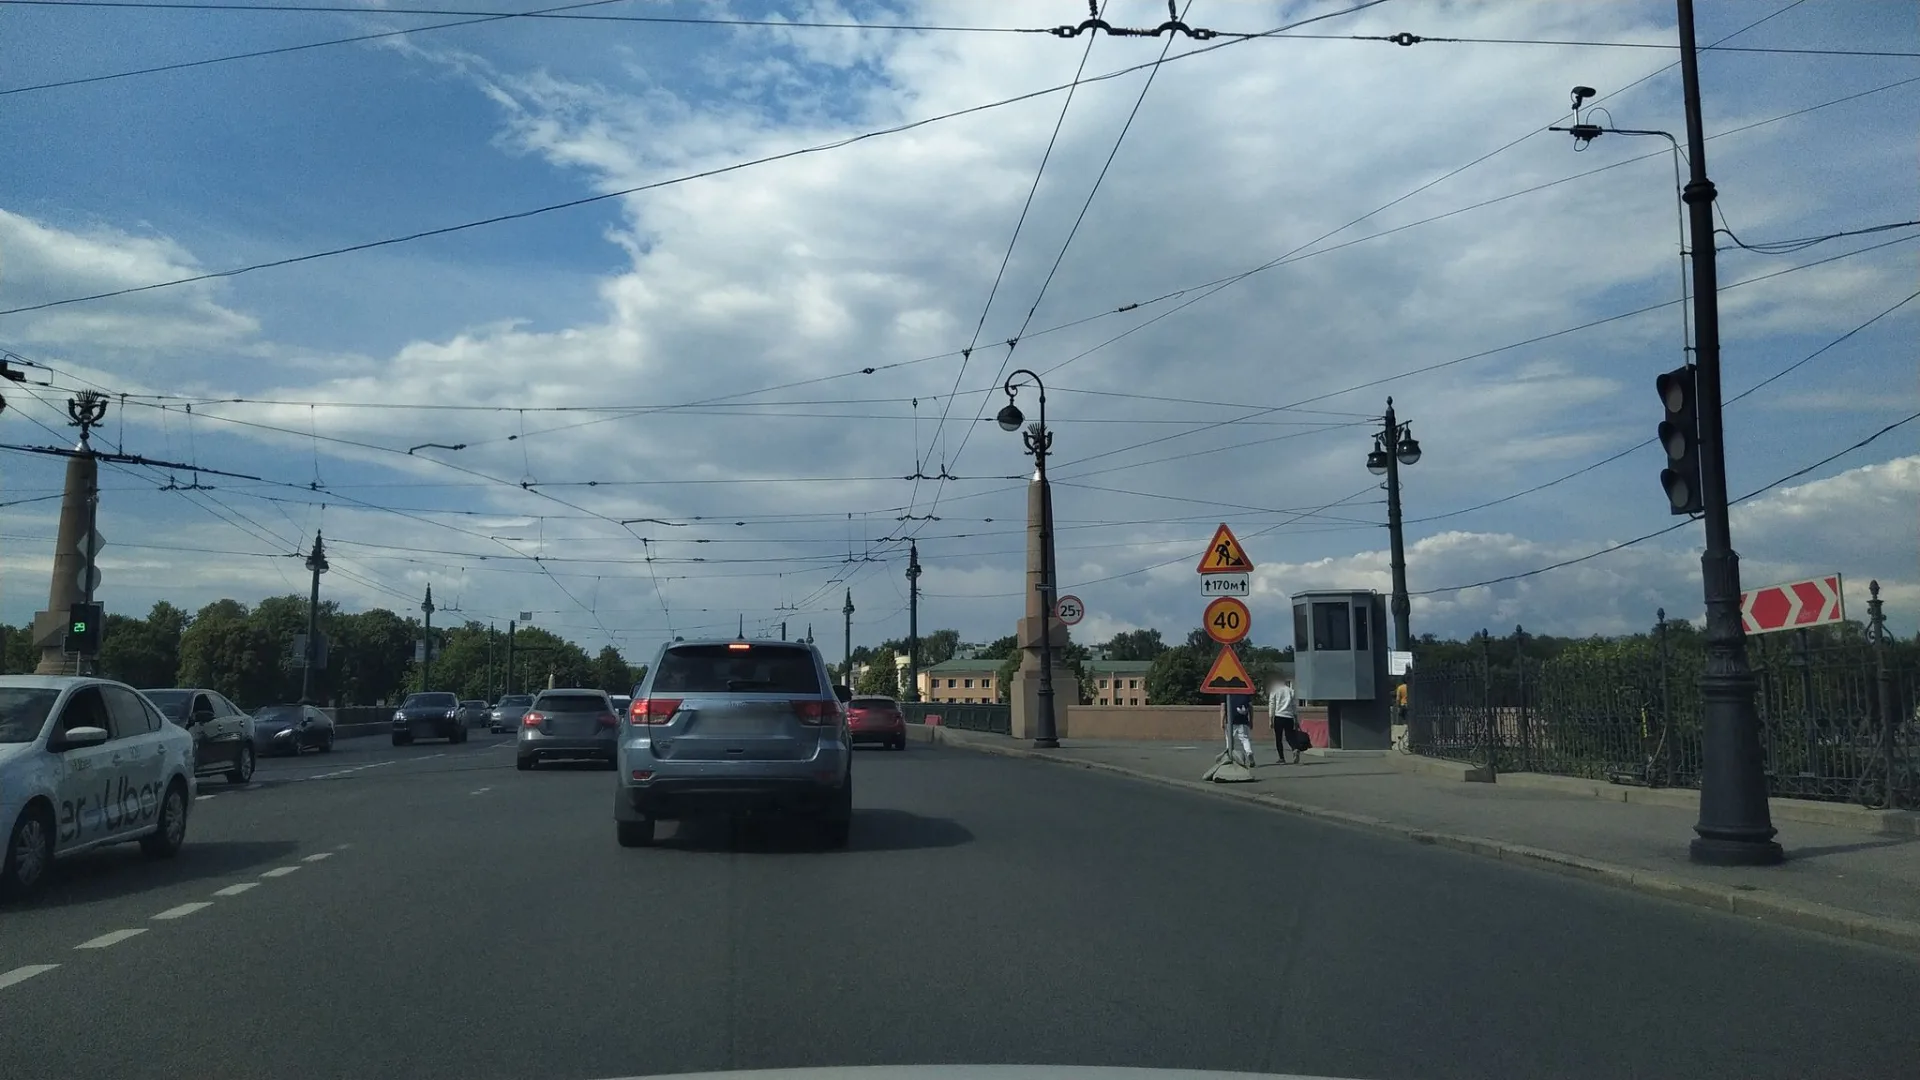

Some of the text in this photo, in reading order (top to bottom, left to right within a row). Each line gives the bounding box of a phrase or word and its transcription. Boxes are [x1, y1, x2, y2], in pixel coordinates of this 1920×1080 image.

[74, 622, 86, 632] 29
[1213, 611, 1239, 629] 40
[104, 775, 163, 831] Uber
